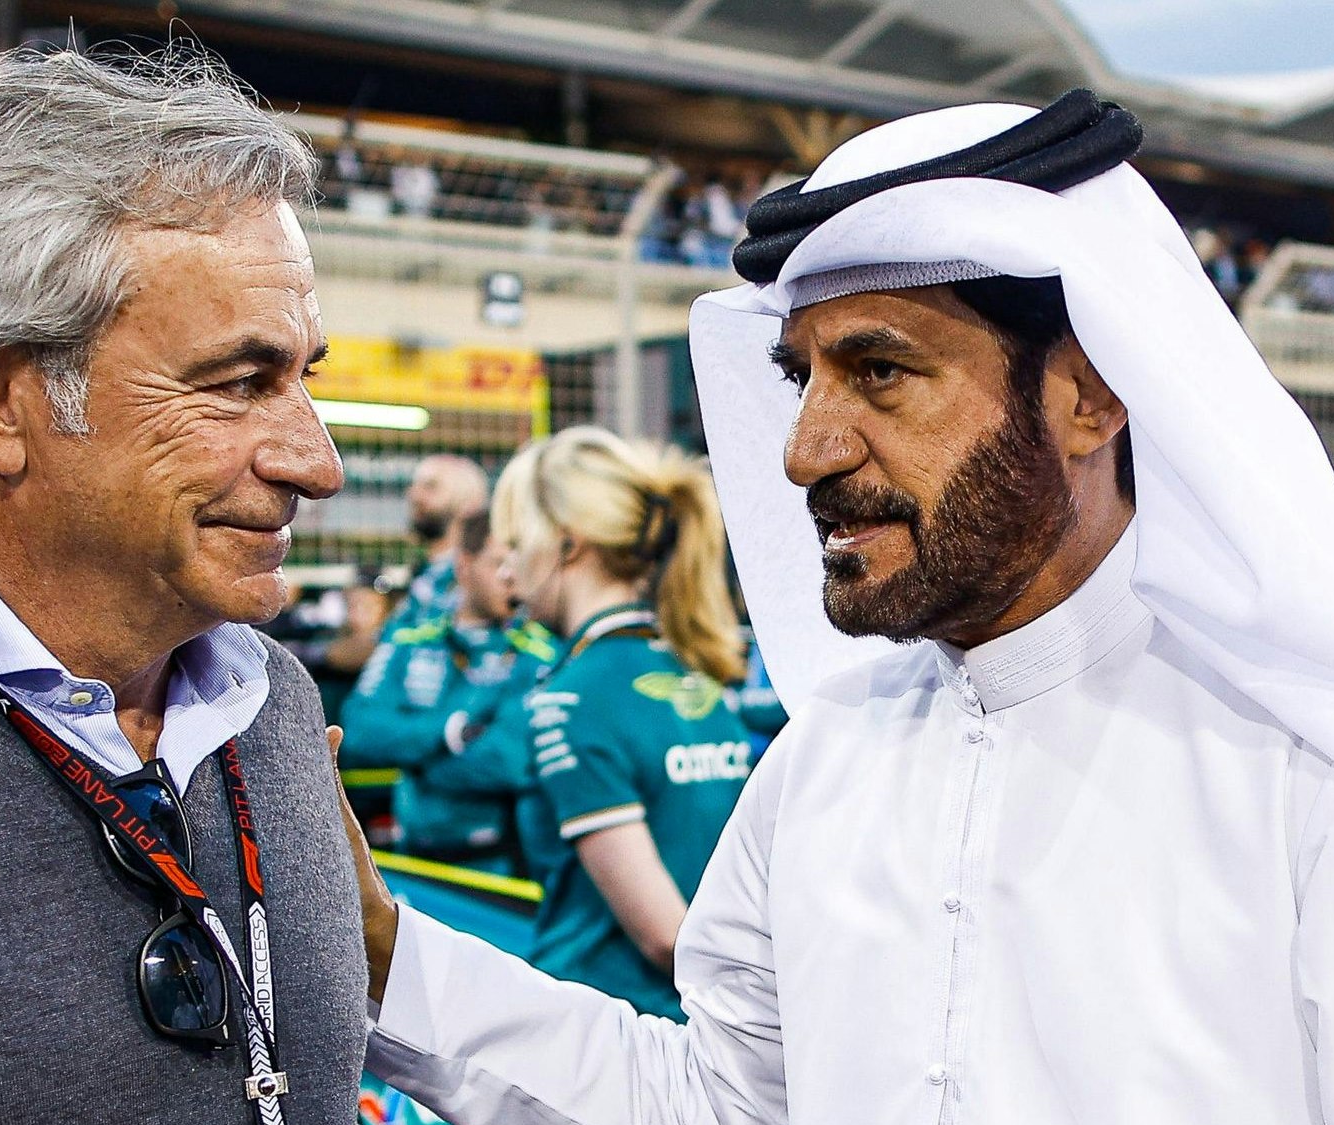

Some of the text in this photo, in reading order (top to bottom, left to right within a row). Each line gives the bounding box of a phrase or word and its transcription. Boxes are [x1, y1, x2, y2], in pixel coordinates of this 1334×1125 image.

[63, 758, 158, 851] PIT LANE
[235, 794, 254, 831] PIT
[252, 918, 272, 987] ACCESS
